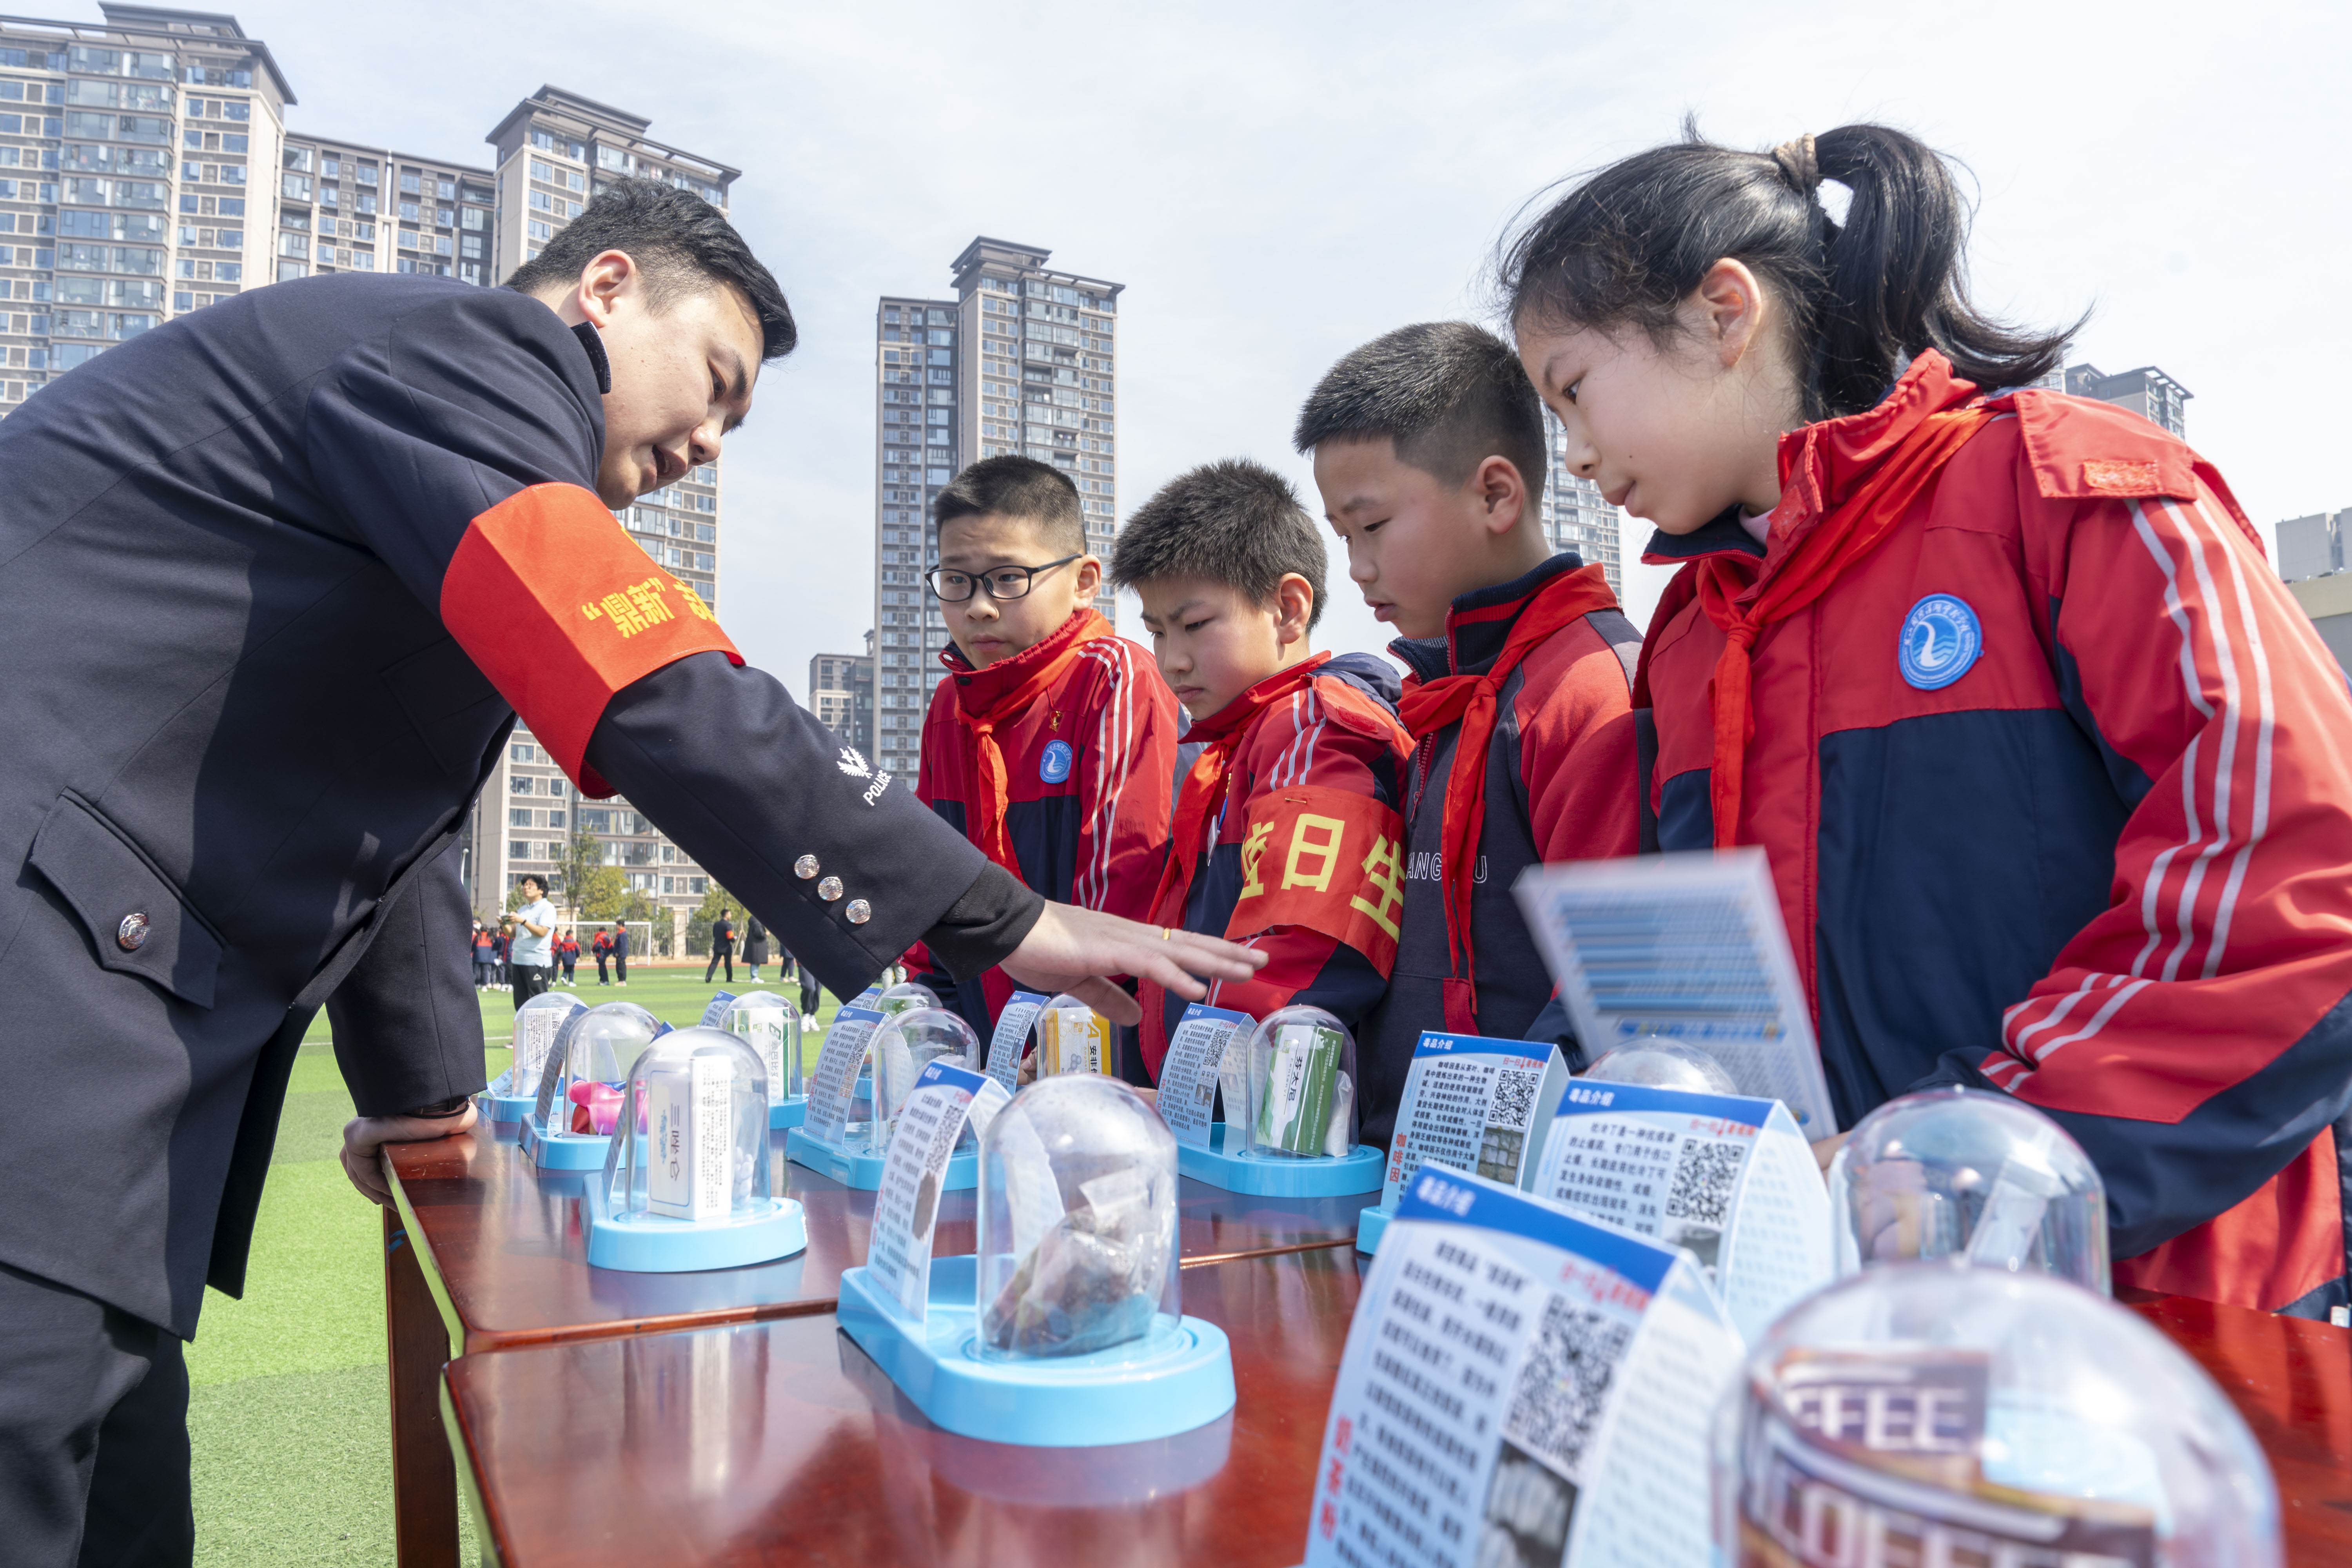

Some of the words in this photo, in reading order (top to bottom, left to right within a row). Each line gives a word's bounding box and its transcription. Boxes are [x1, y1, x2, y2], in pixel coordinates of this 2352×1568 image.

[863, 769, 892, 806] POLICE
[1423, 1038, 1454, 1050] 毒品介绍
[1425, 1069, 1487, 1084] 果中提炼出来的一种生物
[1438, 1061, 1495, 1074] 咖啡因是从茶叶、咖啡
[1289, 1056, 1303, 1101] 芬太尼
[1568, 1087, 1615, 1107] 毒品介绍
[1389, 1132, 1407, 1183] 咖啡因
